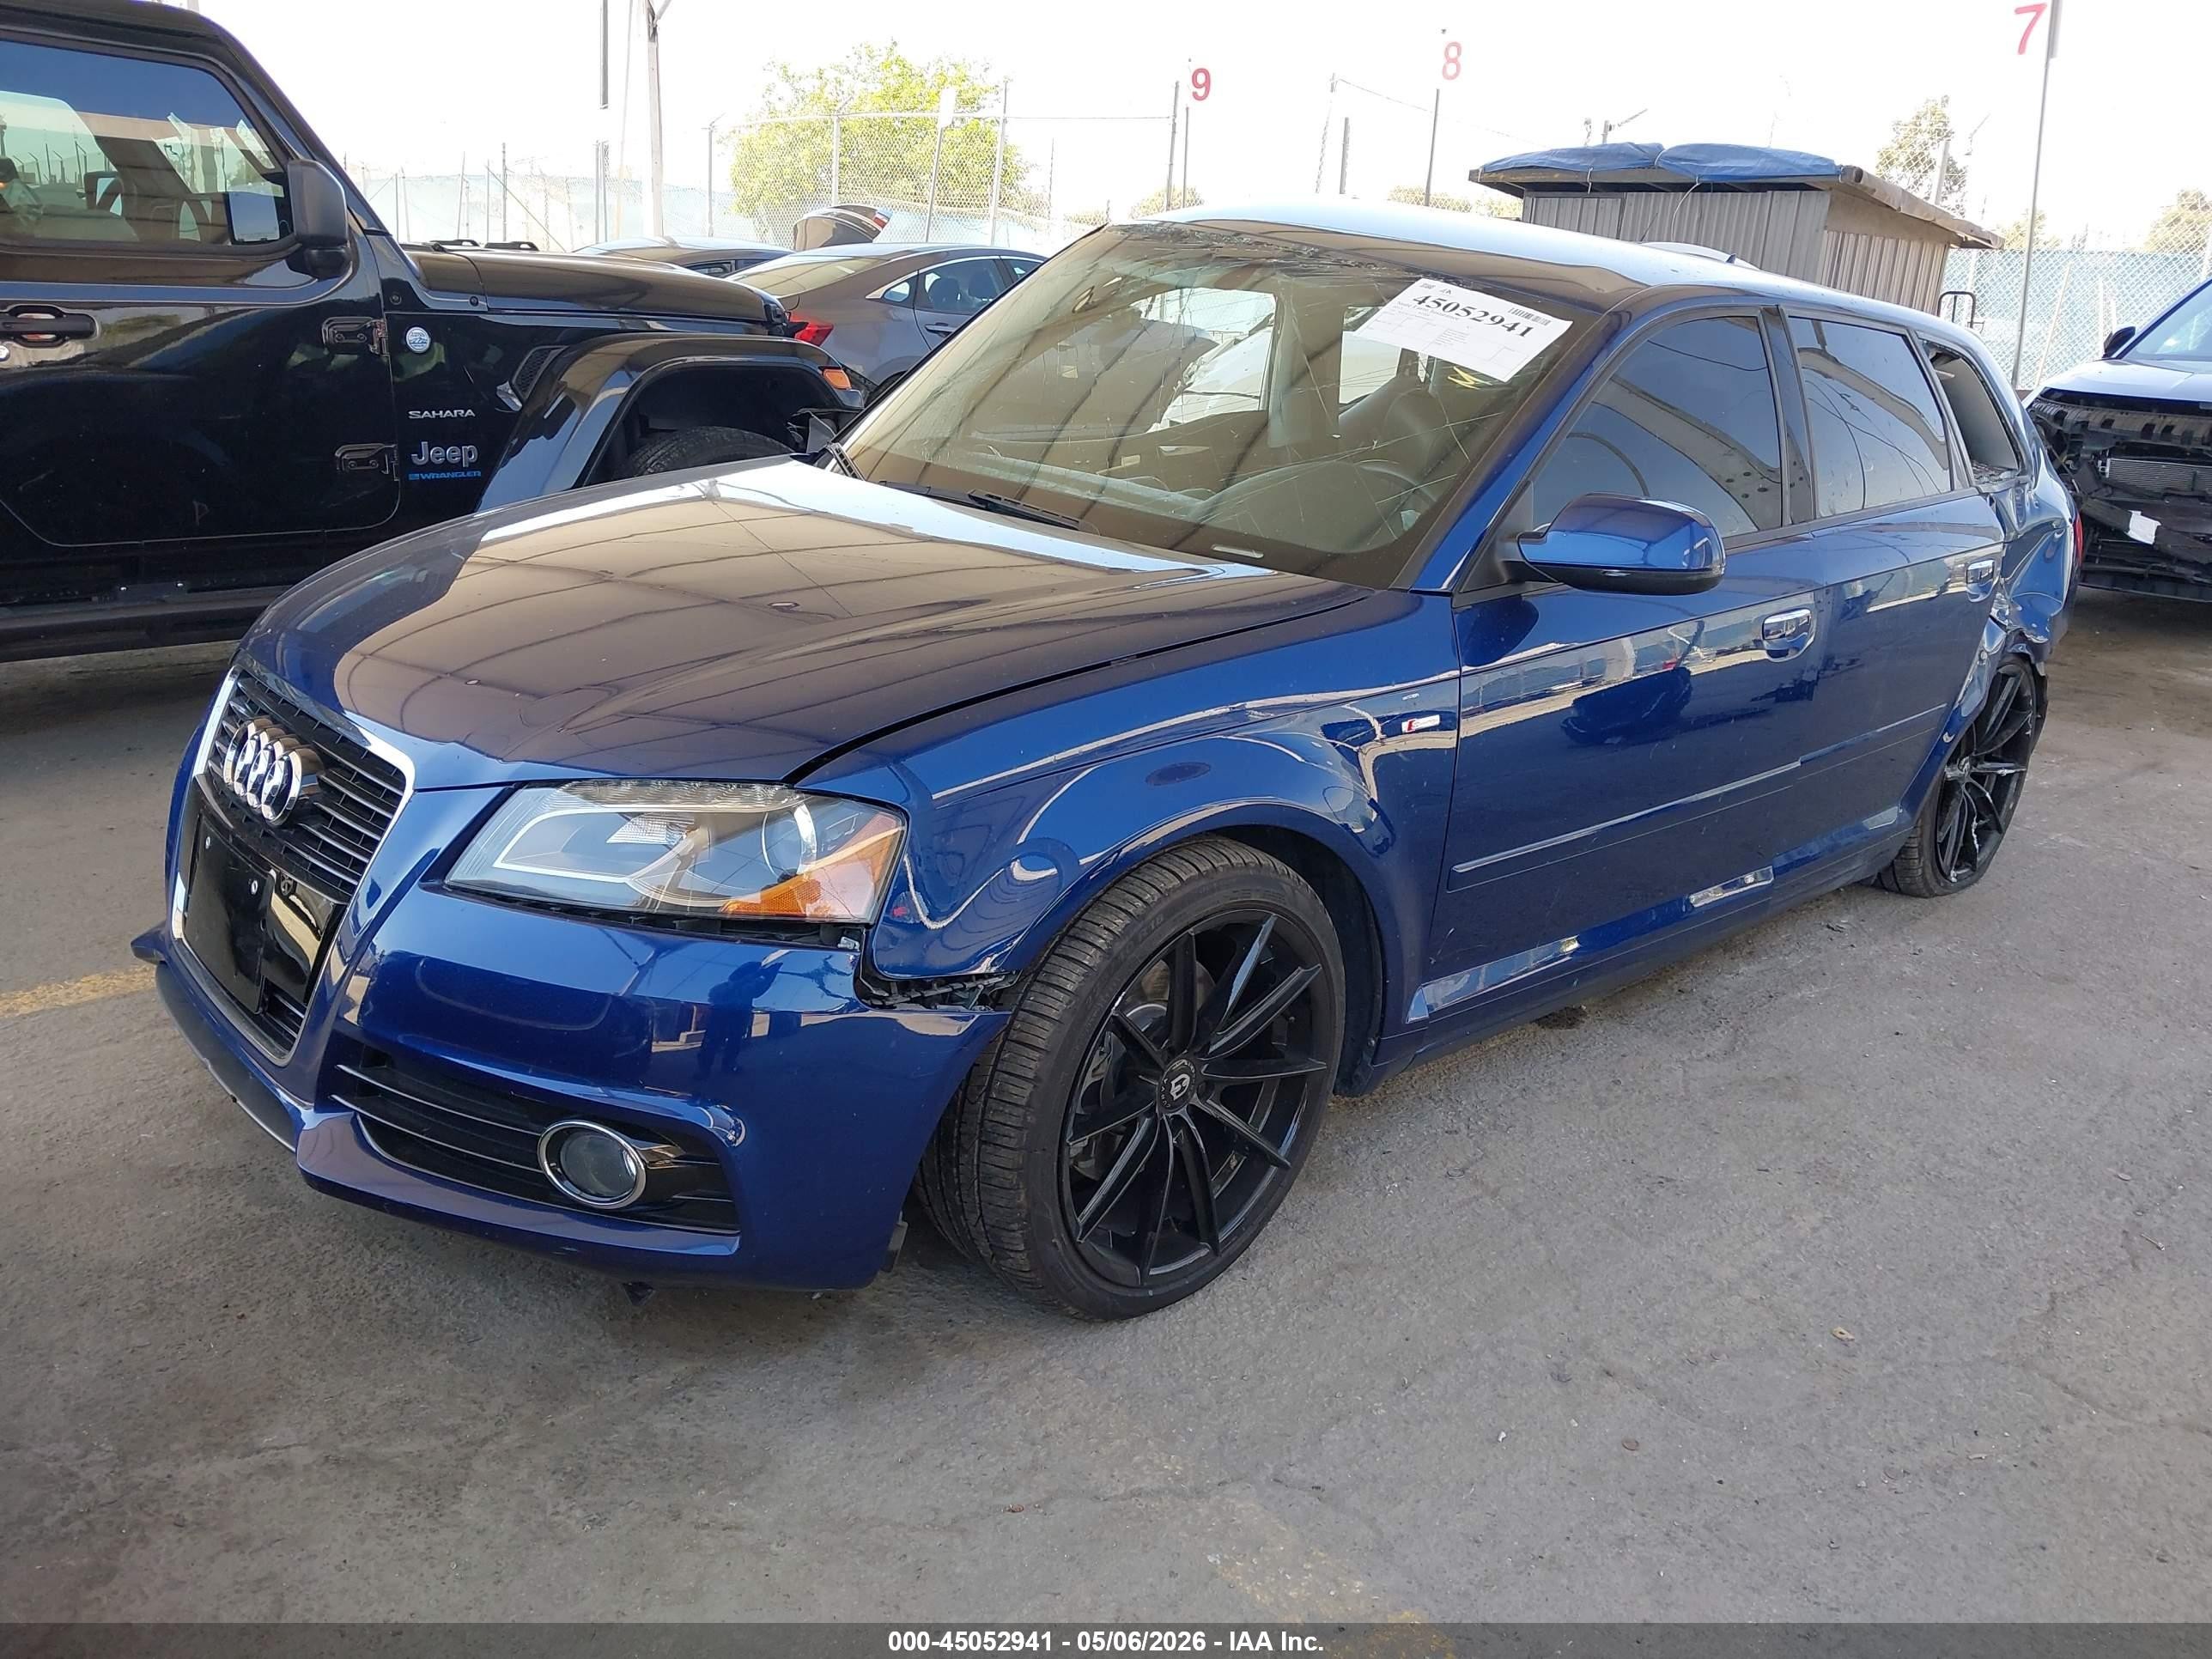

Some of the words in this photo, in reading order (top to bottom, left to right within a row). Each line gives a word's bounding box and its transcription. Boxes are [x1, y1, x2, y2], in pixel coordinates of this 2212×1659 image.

[2014, 3, 2047, 55] 7
[1442, 41, 1462, 80] 8
[1192, 68, 1211, 100] 9
[1413, 295, 1534, 337] 45052941
[408, 409, 476, 419] SAHARA
[410, 441, 478, 468] Jeep
[419, 471, 482, 481] WRANGLER
